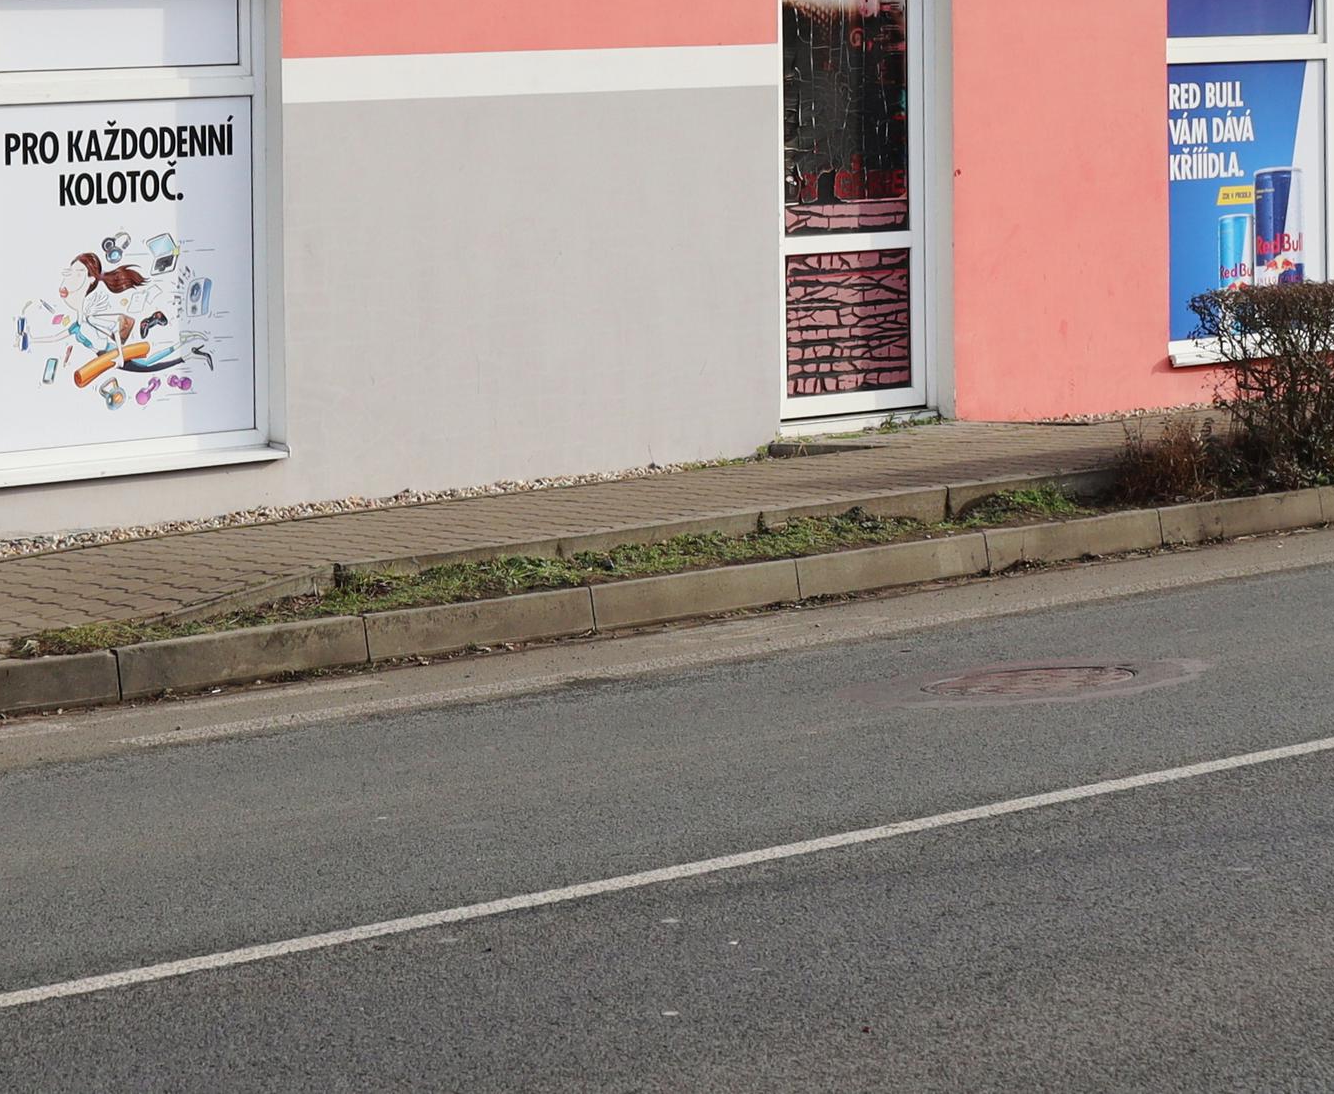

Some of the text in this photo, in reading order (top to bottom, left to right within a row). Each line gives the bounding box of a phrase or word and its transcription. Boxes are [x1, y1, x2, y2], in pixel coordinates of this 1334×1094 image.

[1169, 81, 1244, 110] RED BULL
[4, 115, 234, 166] PRO KAŽDODENNÍ
[1169, 109, 1255, 145] VÁM DÁVÁ
[1170, 146, 1245, 181] KŘÍÍÍDLA.
[59, 160, 184, 207] KOLOTOČ.
[1256, 233, 1280, 255] Red
[1220, 263, 1238, 280] Red
